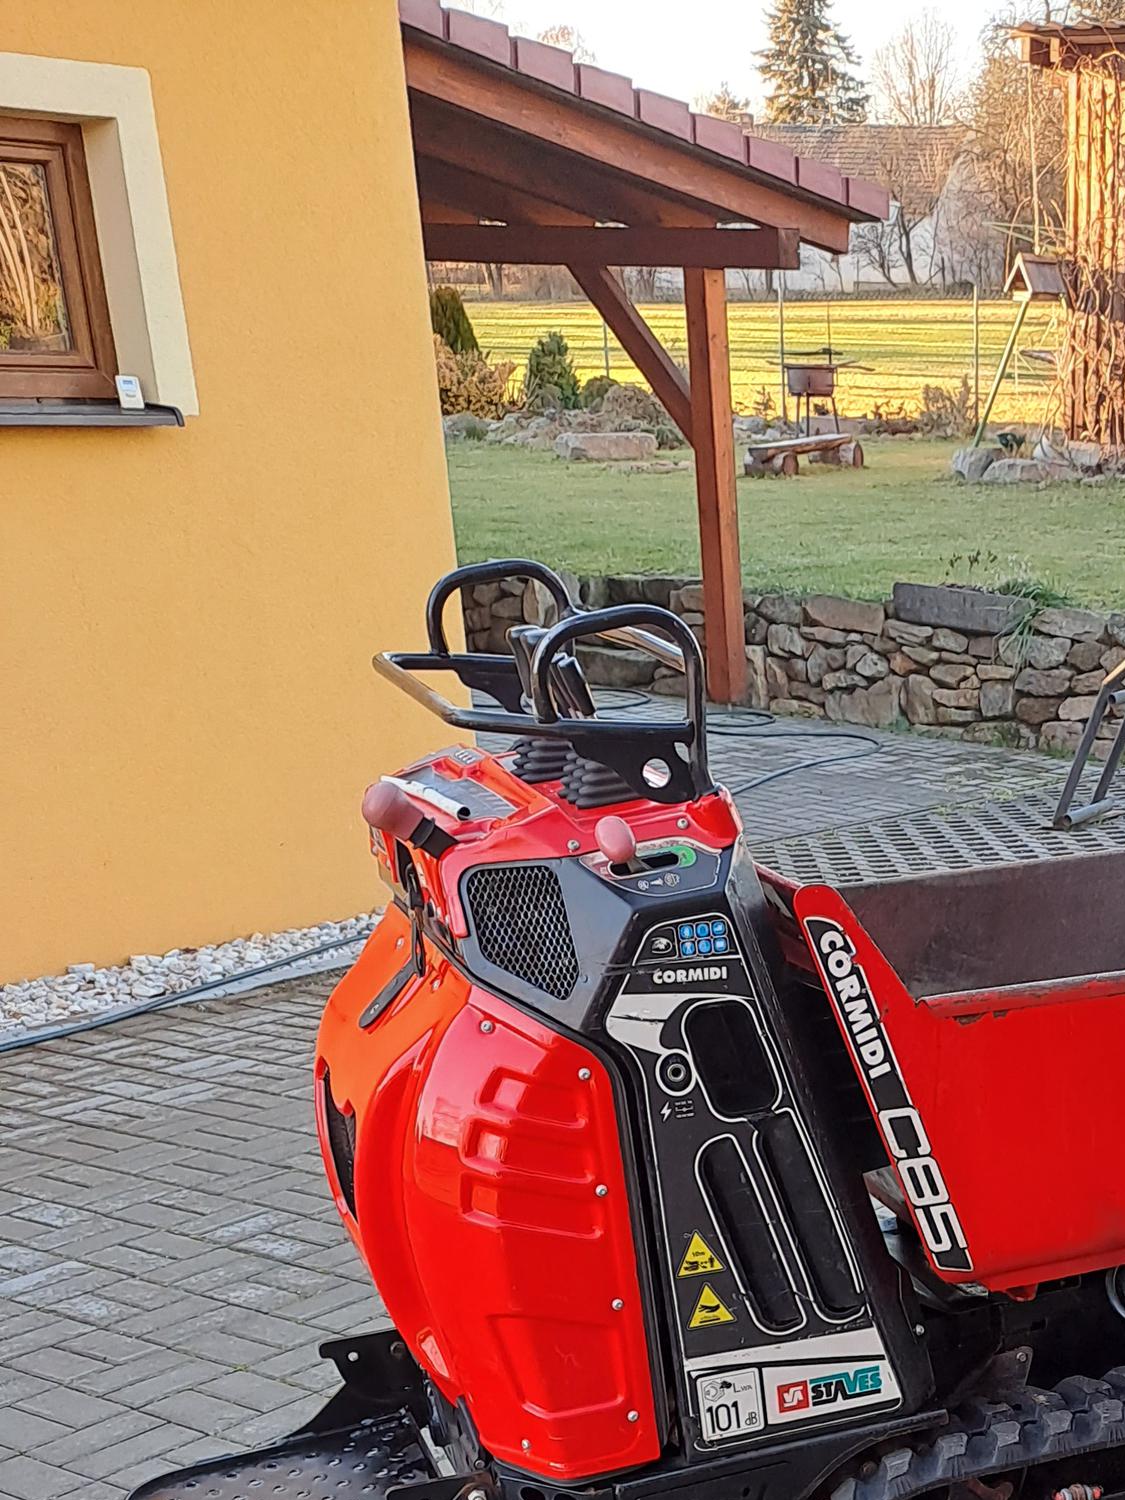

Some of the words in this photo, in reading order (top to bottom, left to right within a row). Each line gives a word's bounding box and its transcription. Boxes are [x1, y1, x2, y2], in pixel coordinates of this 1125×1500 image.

[653, 967, 727, 984] CORMIDI
[820, 930, 891, 1079] CORMIDI
[879, 1107, 968, 1253] C85
[811, 1370, 882, 1401] STAVES
[706, 1400, 741, 1434] 101
[745, 1411, 758, 1426] dB
